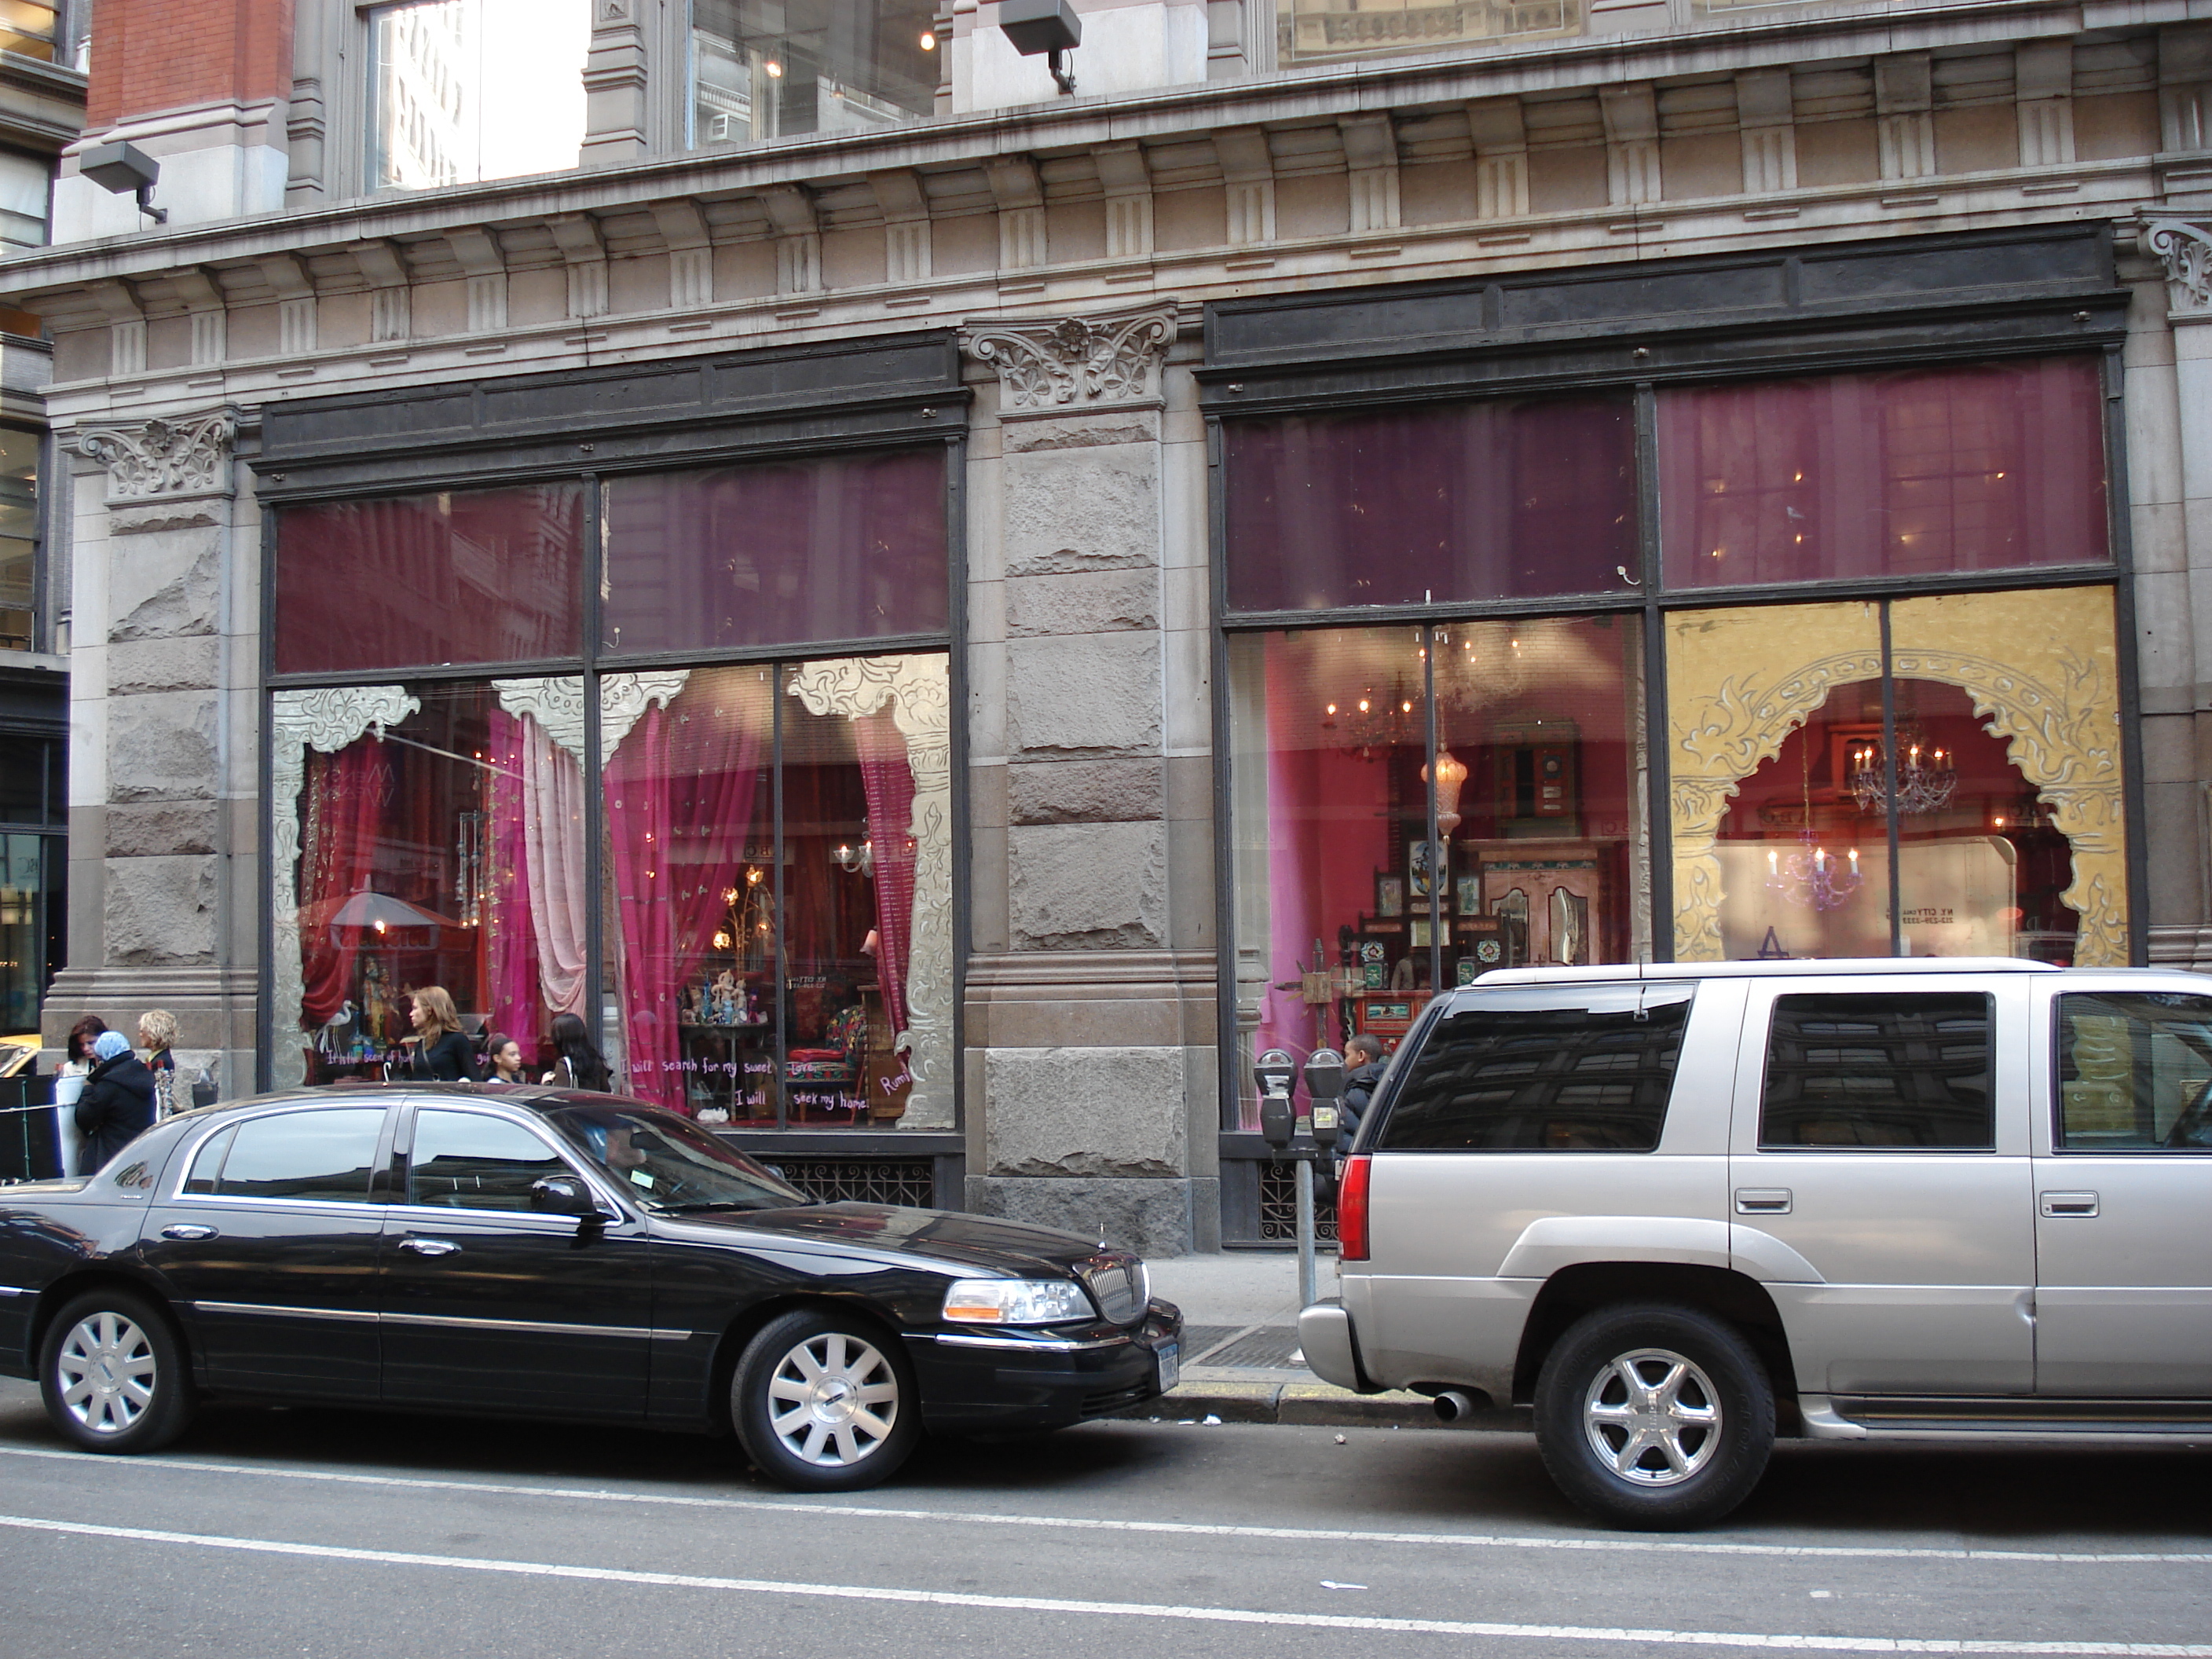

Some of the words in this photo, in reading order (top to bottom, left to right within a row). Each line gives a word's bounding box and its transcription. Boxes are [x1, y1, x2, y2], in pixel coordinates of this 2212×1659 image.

[364, 1050, 384, 1064] scent
[387, 1049, 395, 1064] of
[632, 1060, 653, 1074] will
[661, 1057, 698, 1072] search
[703, 1057, 719, 1075] for
[723, 1061, 737, 1079] my
[744, 1061, 774, 1074] sweet
[880, 1071, 912, 1097] Rumi
[735, 1089, 744, 1106] I
[746, 1090, 767, 1105] will
[793, 1092, 818, 1105] seek
[821, 1094, 835, 1111] my
